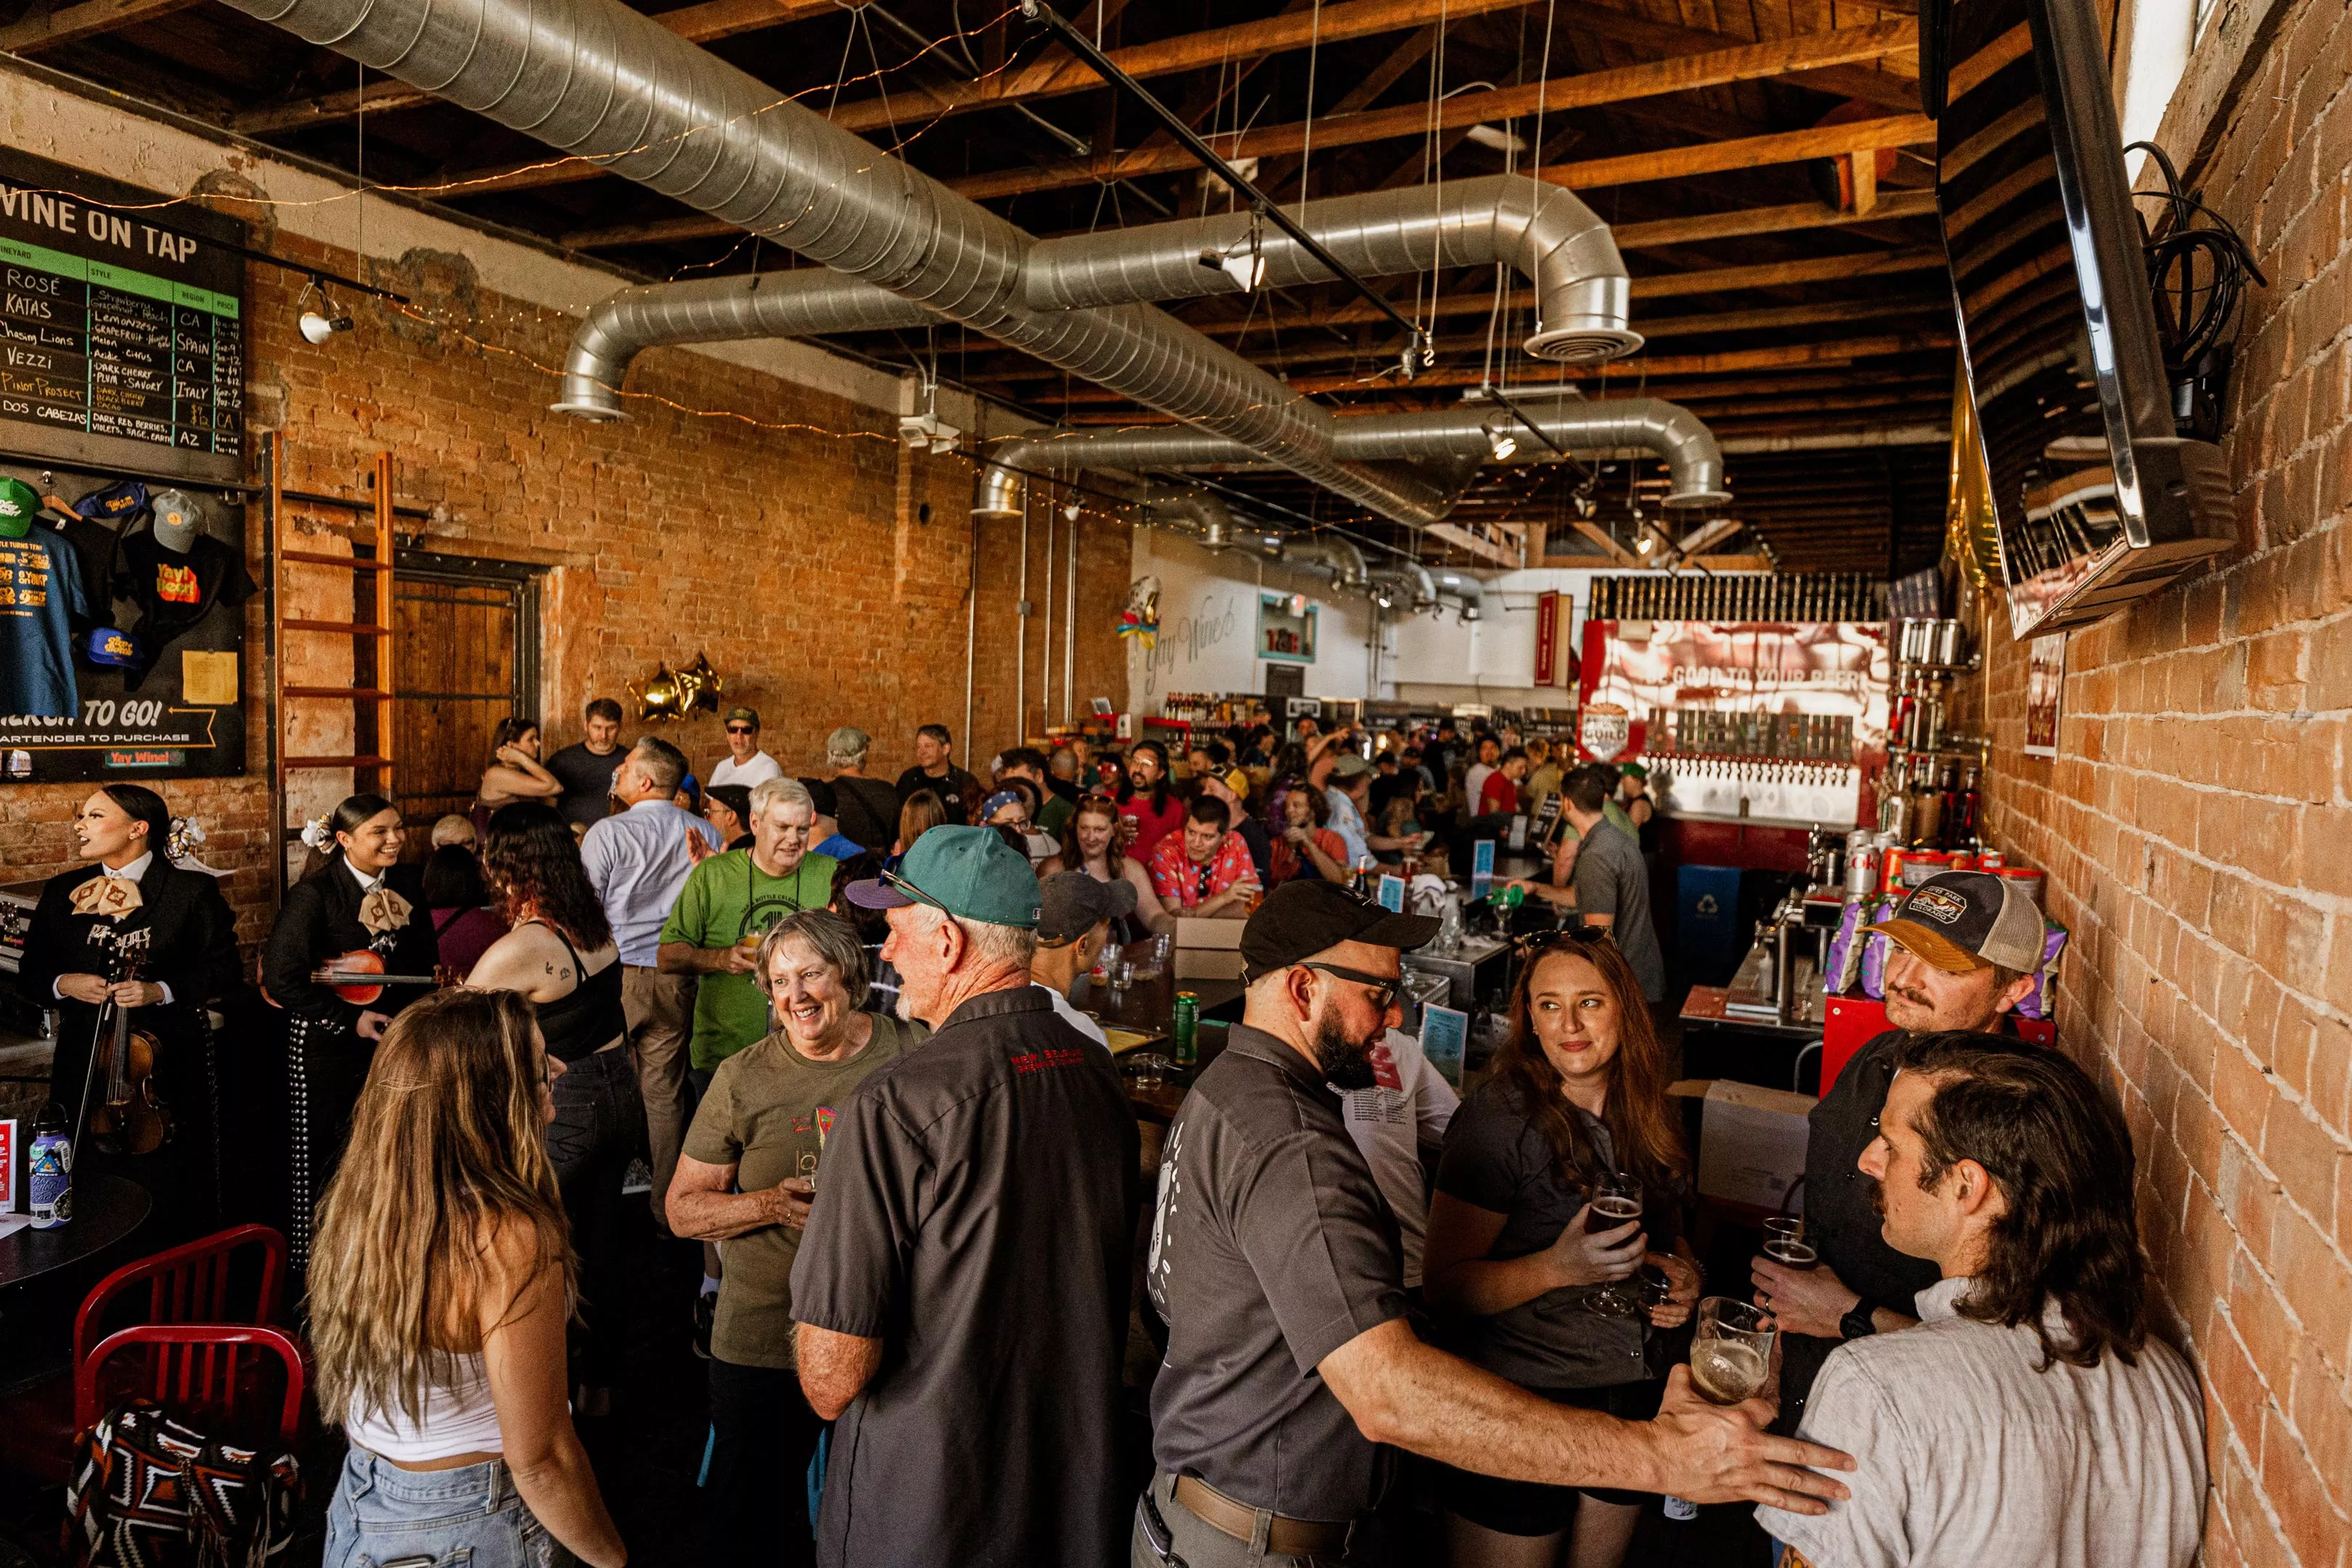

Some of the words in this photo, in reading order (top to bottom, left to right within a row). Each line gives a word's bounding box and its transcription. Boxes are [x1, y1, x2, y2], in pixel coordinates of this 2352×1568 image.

[88, 211, 131, 248] ON
[141, 225, 197, 264] TAP
[0, 246, 31, 259] INEYARD
[91, 268, 110, 279] STYLE
[8, 269, 60, 296] ROSÉ
[182, 291, 204, 303] REGION
[6, 293, 52, 318] KATAS
[217, 300, 234, 311] PRICE
[181, 312, 200, 327] CA
[41, 327, 74, 346] Lions
[95, 362, 121, 374] DARK
[121, 367, 152, 380] CHERRY
[176, 358, 195, 374] CA
[97, 371, 118, 385] PLUM
[127, 377, 163, 391] SAVORY
[176, 381, 208, 400] ITALY
[4, 400, 30, 414] DOS
[37, 407, 87, 425] CABEZAS
[93, 413, 115, 425] DARK
[118, 417, 134, 428] RED
[217, 412, 234, 429] CA
[180, 430, 200, 446] AZ
[158, 563, 189, 583] Yay!
[1673, 664, 1723, 689] GOOD
[1726, 666, 1751, 689] TO
[1755, 667, 1807, 690] YOUR
[85, 699, 115, 727] TO
[120, 699, 163, 727] GO!
[114, 733, 189, 743] PURCHASE
[1585, 729, 1627, 741] GUILD
[755, 894, 776, 903] BOTTLE
[1945, 892, 1961, 903] PARK
[1912, 904, 1947, 920] COLORADO
